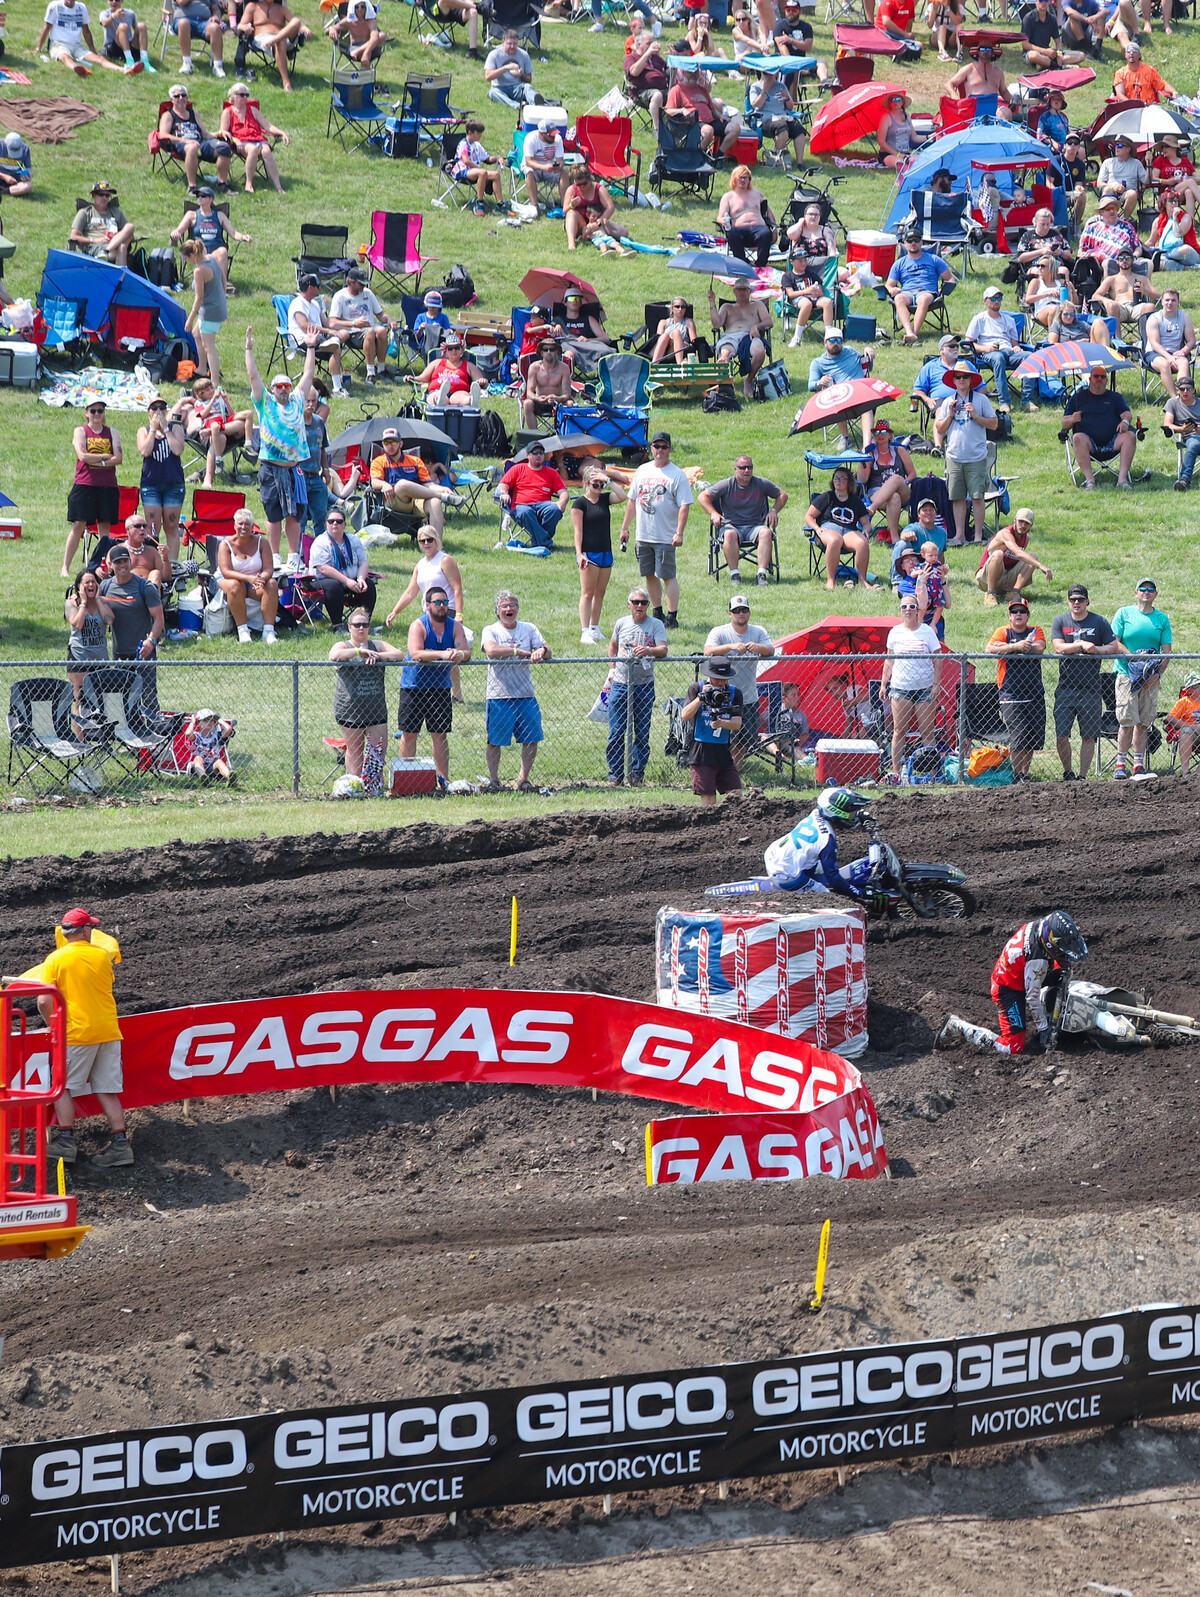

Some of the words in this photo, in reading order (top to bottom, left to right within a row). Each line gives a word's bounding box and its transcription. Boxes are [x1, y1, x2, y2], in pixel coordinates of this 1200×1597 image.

[81, 627, 101, 638] BIKES
[734, 926, 749, 1024] EDBUD
[815, 924, 828, 1049] REDBUD
[168, 1007, 574, 1081] GASGAS
[621, 1023, 853, 1111] GASG
[25, 1207, 62, 1221] Rentals
[751, 1350, 954, 1417] GEICO
[957, 1323, 1124, 1392] GEICO
[273, 1401, 489, 1470] GEICO
[516, 1375, 727, 1443] GEICO
[779, 1422, 927, 1462] MOTORCYCLE
[971, 1394, 1102, 1437] MOTORCYCLE
[31, 1428, 248, 1501] GEICO
[302, 1476, 465, 1516] MOTORCYCLE
[546, 1449, 702, 1489] MOTORCYCLE
[57, 1505, 221, 1548] MOTORCYCLE
